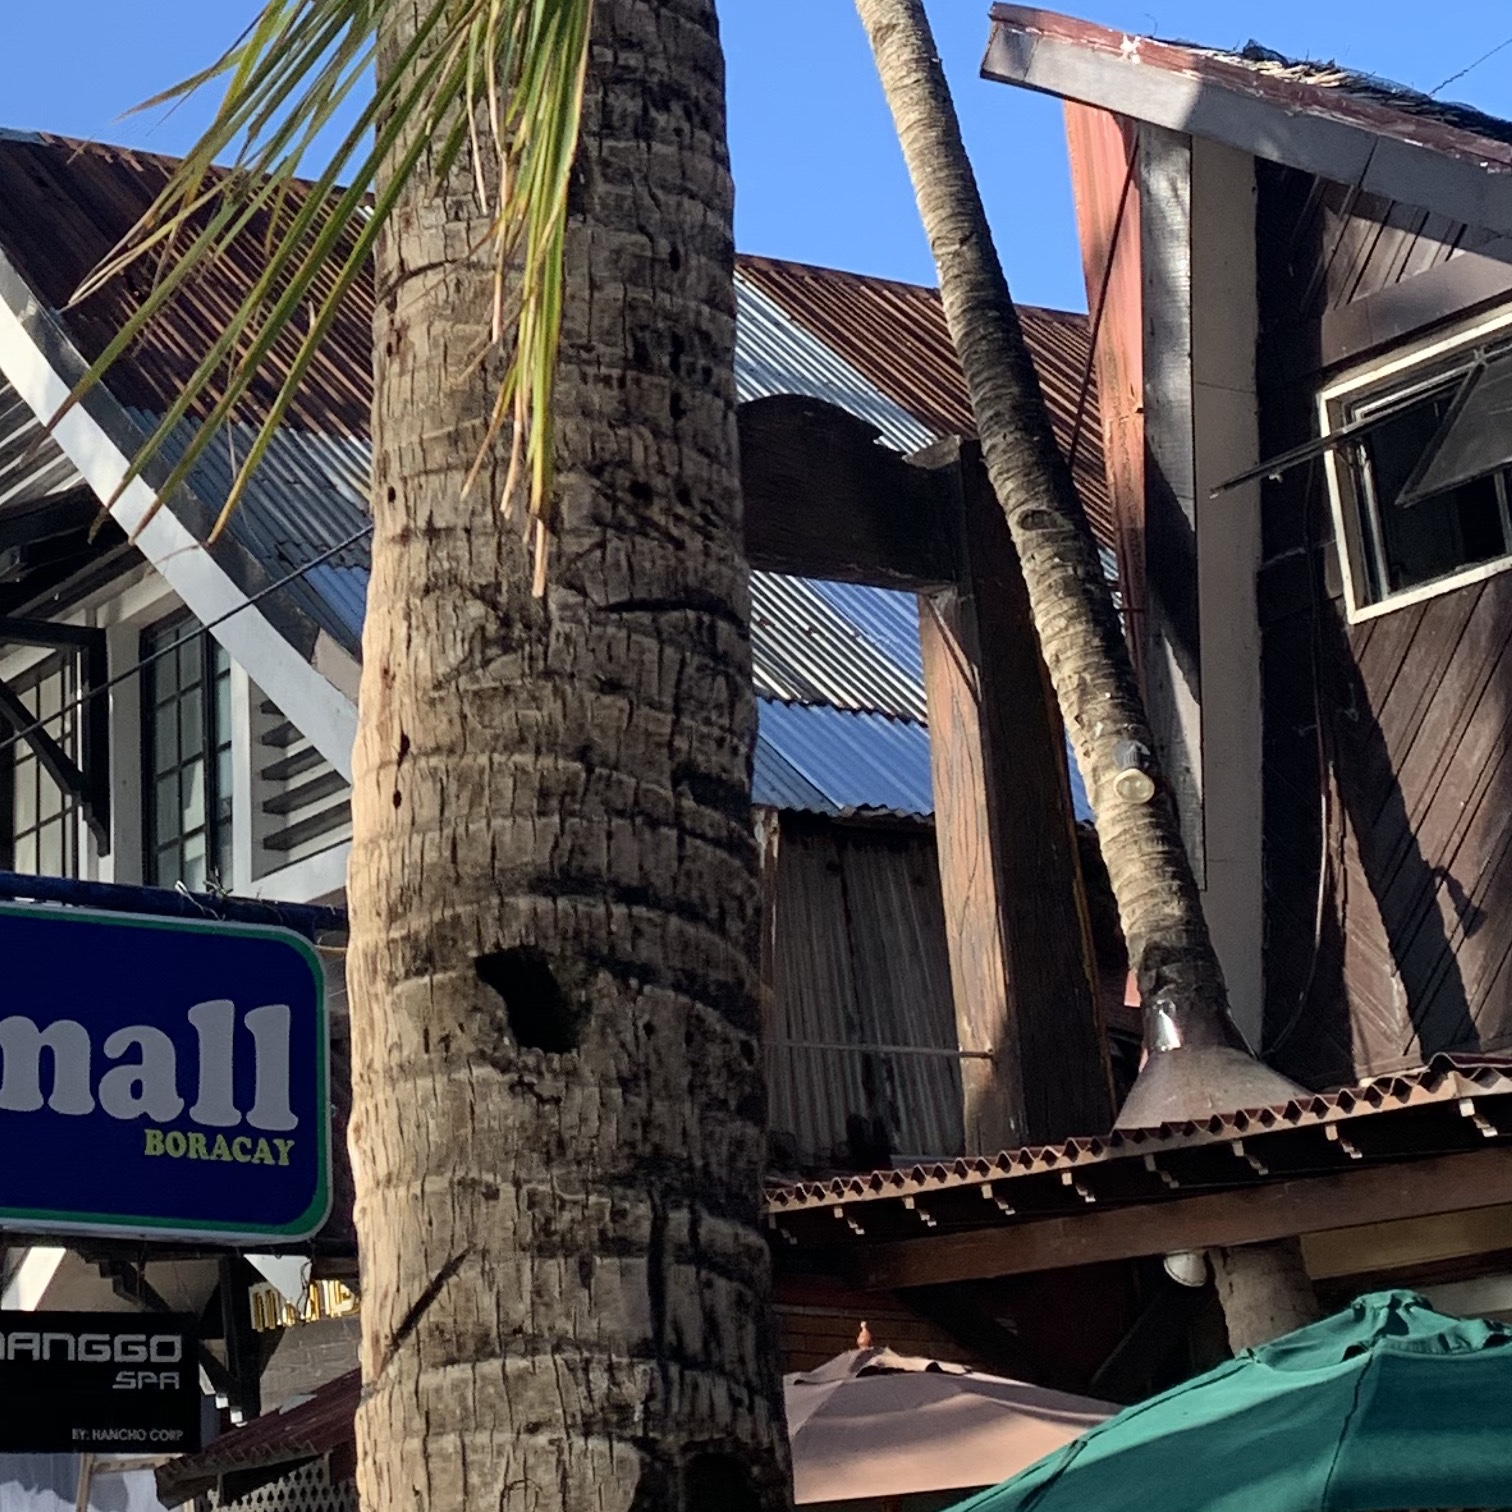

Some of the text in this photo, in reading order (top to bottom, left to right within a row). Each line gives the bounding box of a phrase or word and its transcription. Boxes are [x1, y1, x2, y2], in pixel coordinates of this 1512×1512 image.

[144, 1129, 294, 1166] BORACAY
[112, 1371, 180, 1390] SPA
[149, 1429, 184, 1442] CORP
